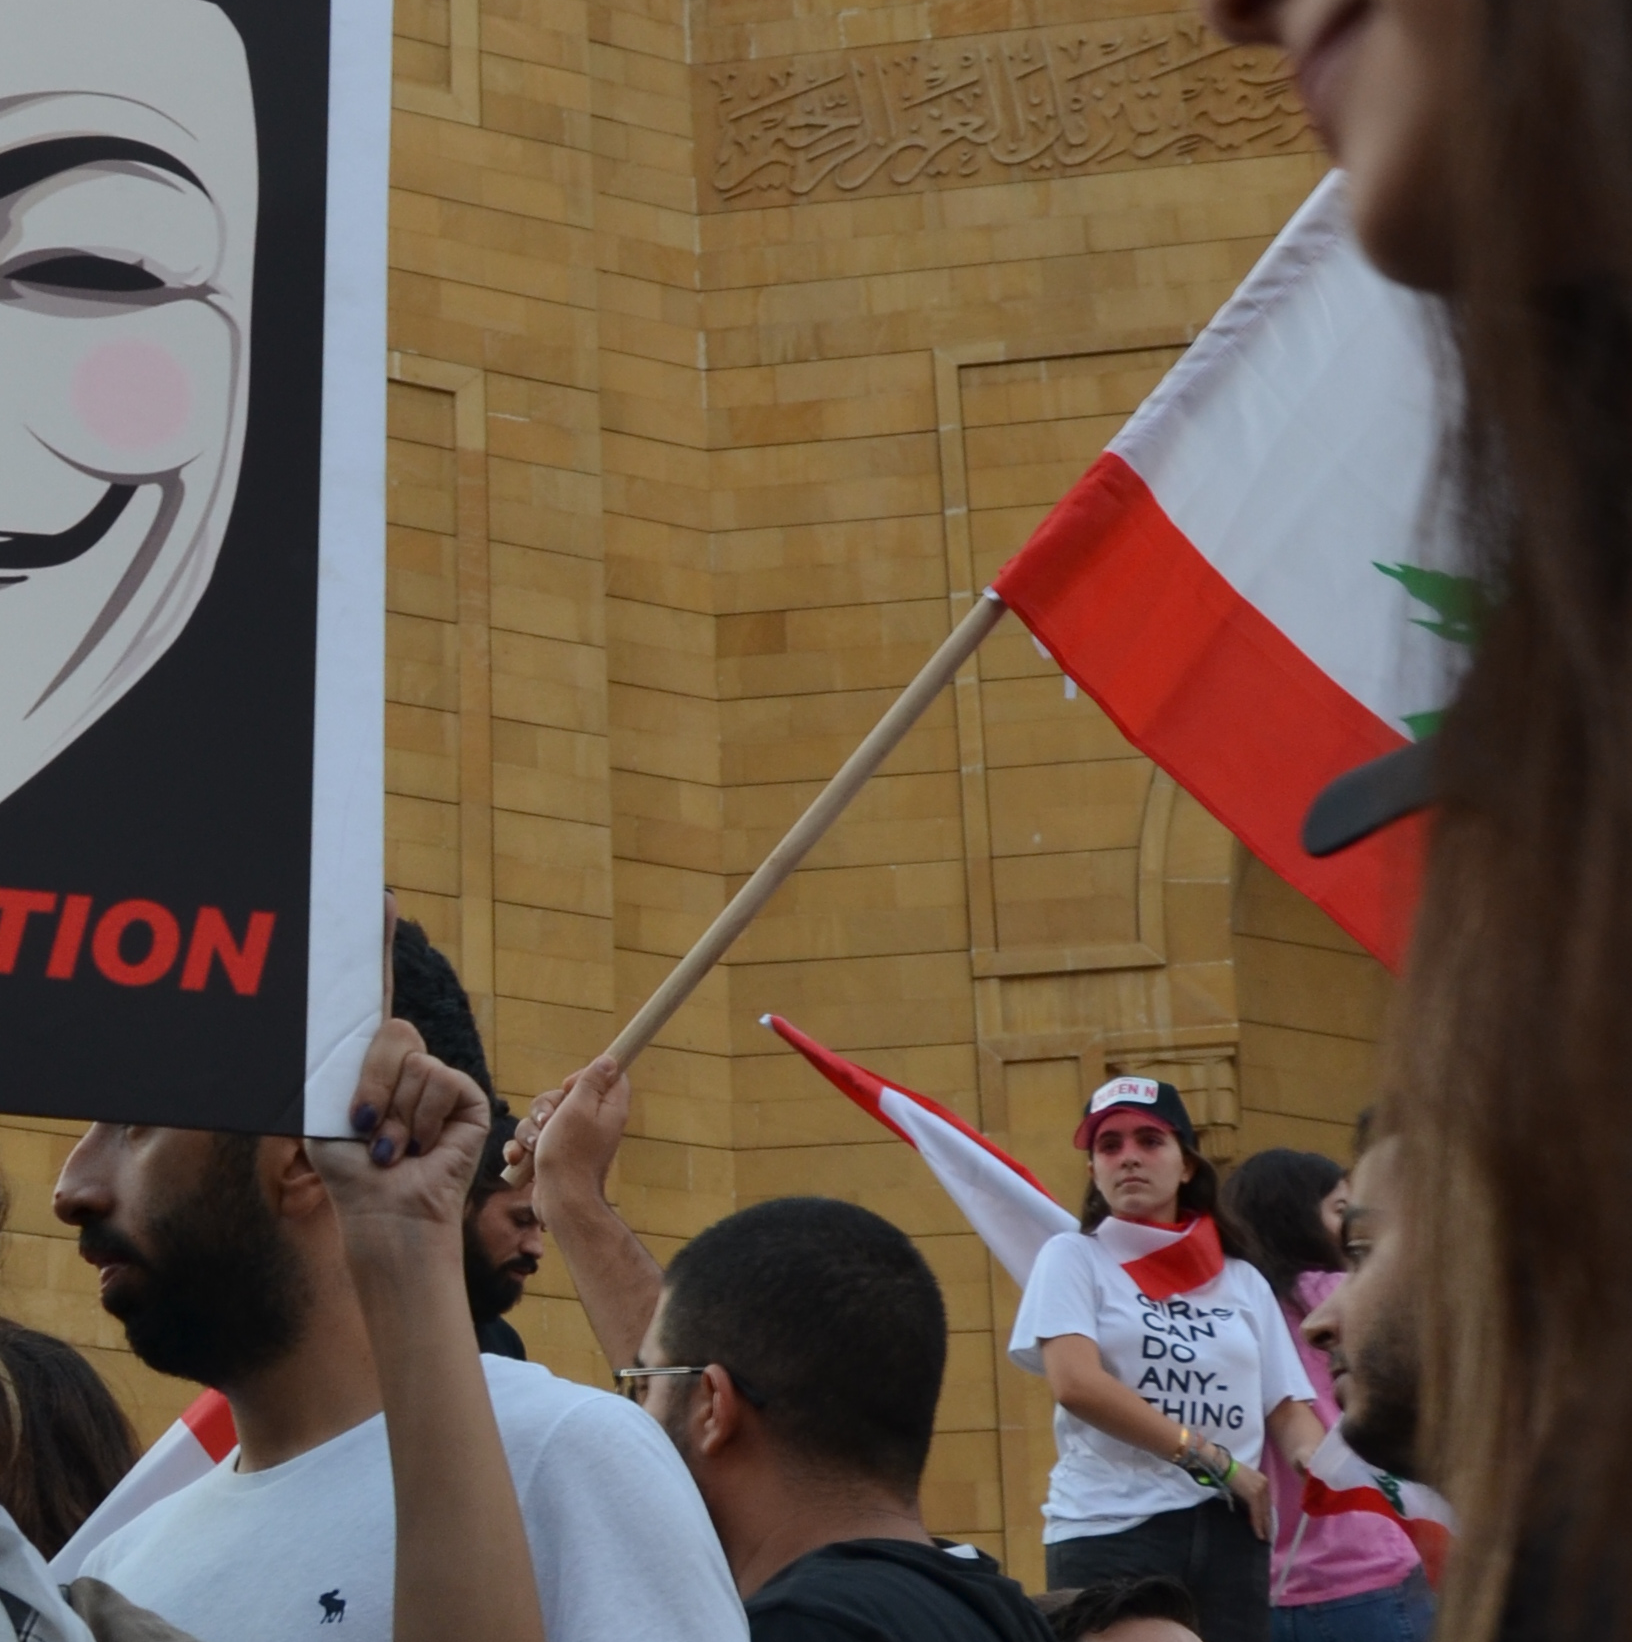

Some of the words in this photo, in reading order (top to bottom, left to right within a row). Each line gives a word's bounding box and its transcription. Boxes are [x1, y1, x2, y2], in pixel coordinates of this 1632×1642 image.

[1142, 1312, 1216, 1342] CAN
[1141, 1334, 1197, 1363] DO
[1137, 1366, 1229, 1395] ANY-
